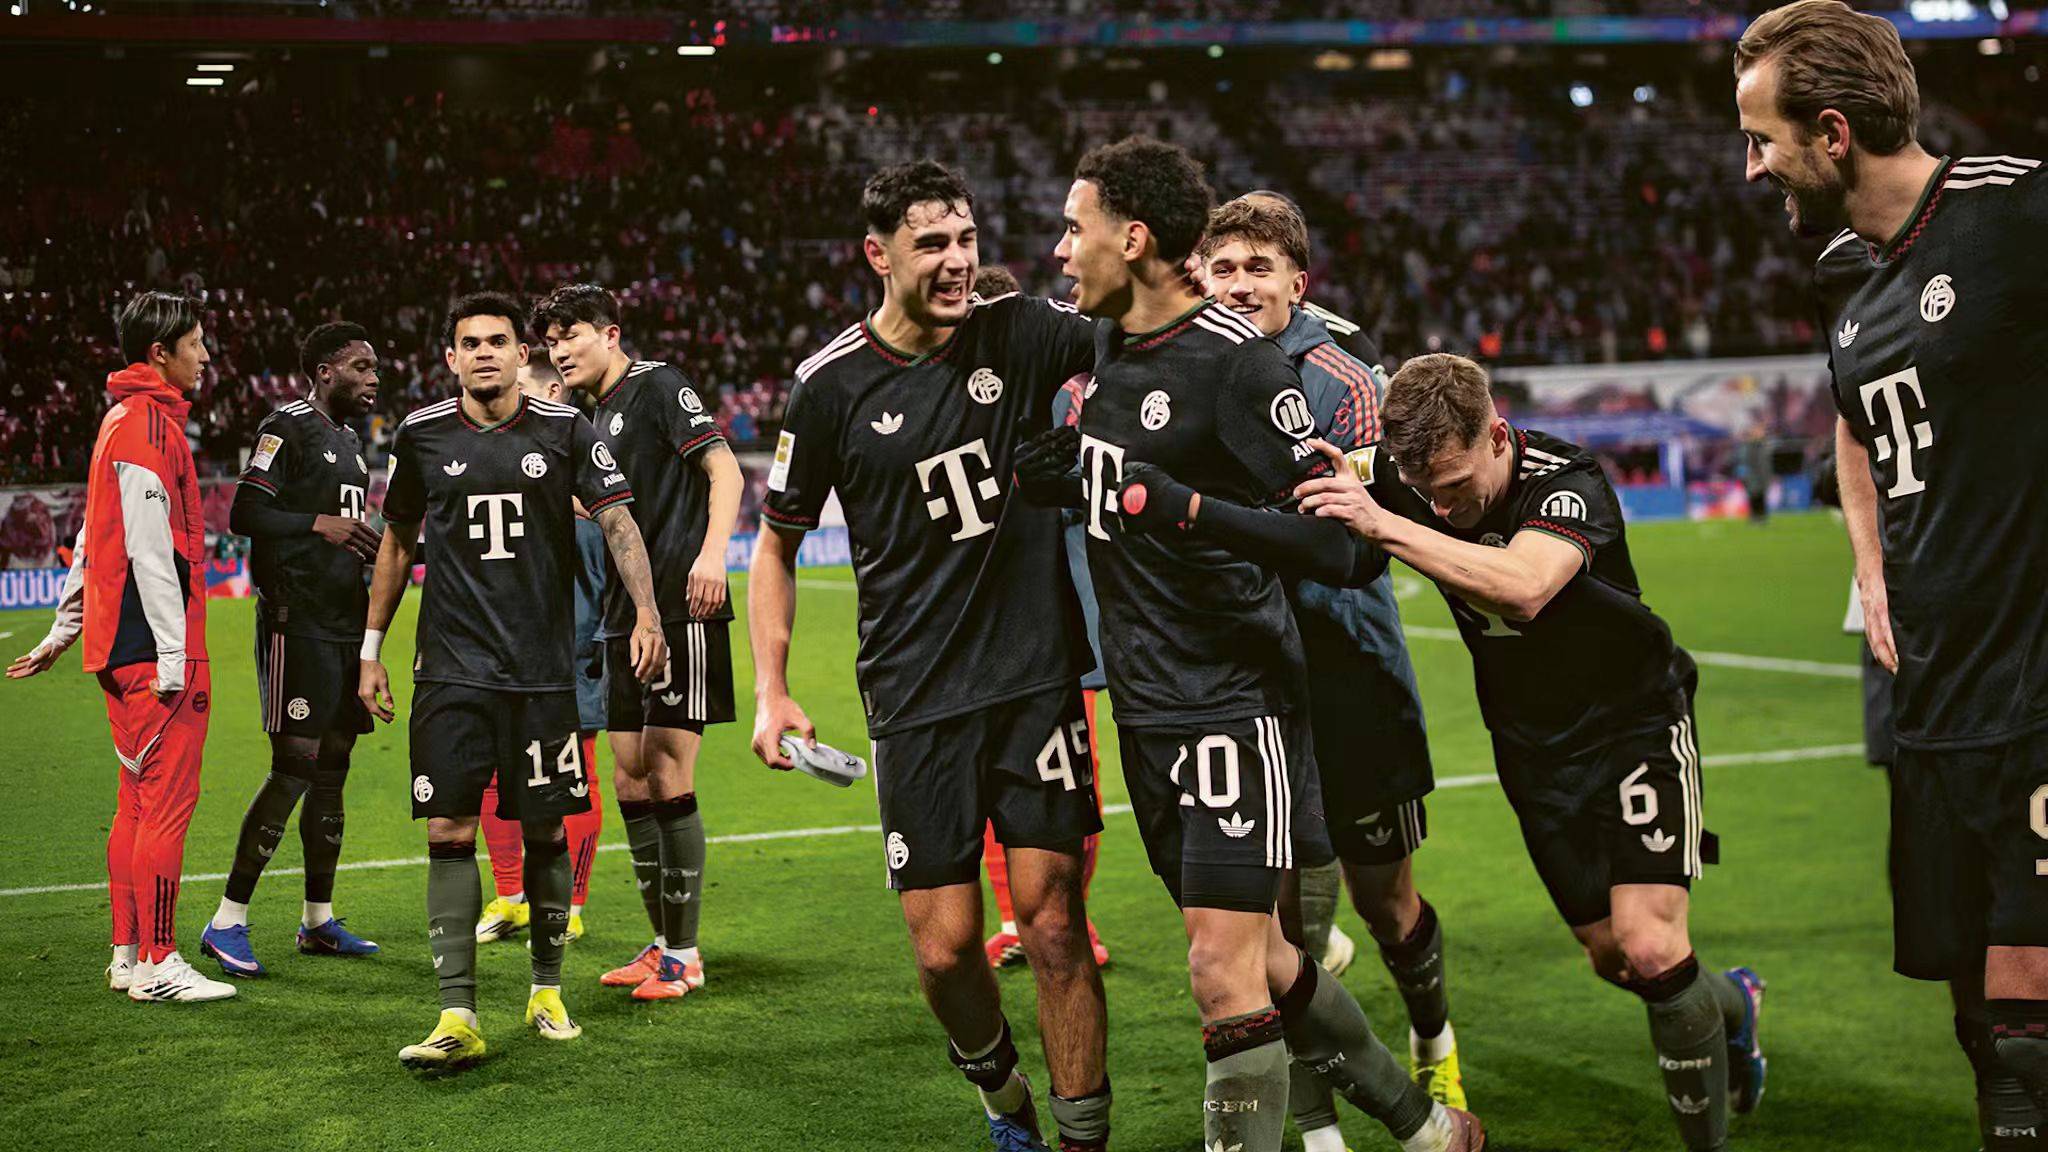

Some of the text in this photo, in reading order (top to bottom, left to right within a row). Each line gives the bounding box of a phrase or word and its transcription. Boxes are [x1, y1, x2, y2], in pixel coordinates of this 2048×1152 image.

[914, 437, 1001, 542] T
[467, 492, 525, 560] T
[525, 731, 583, 788] 14
[1619, 762, 1659, 826] 6
